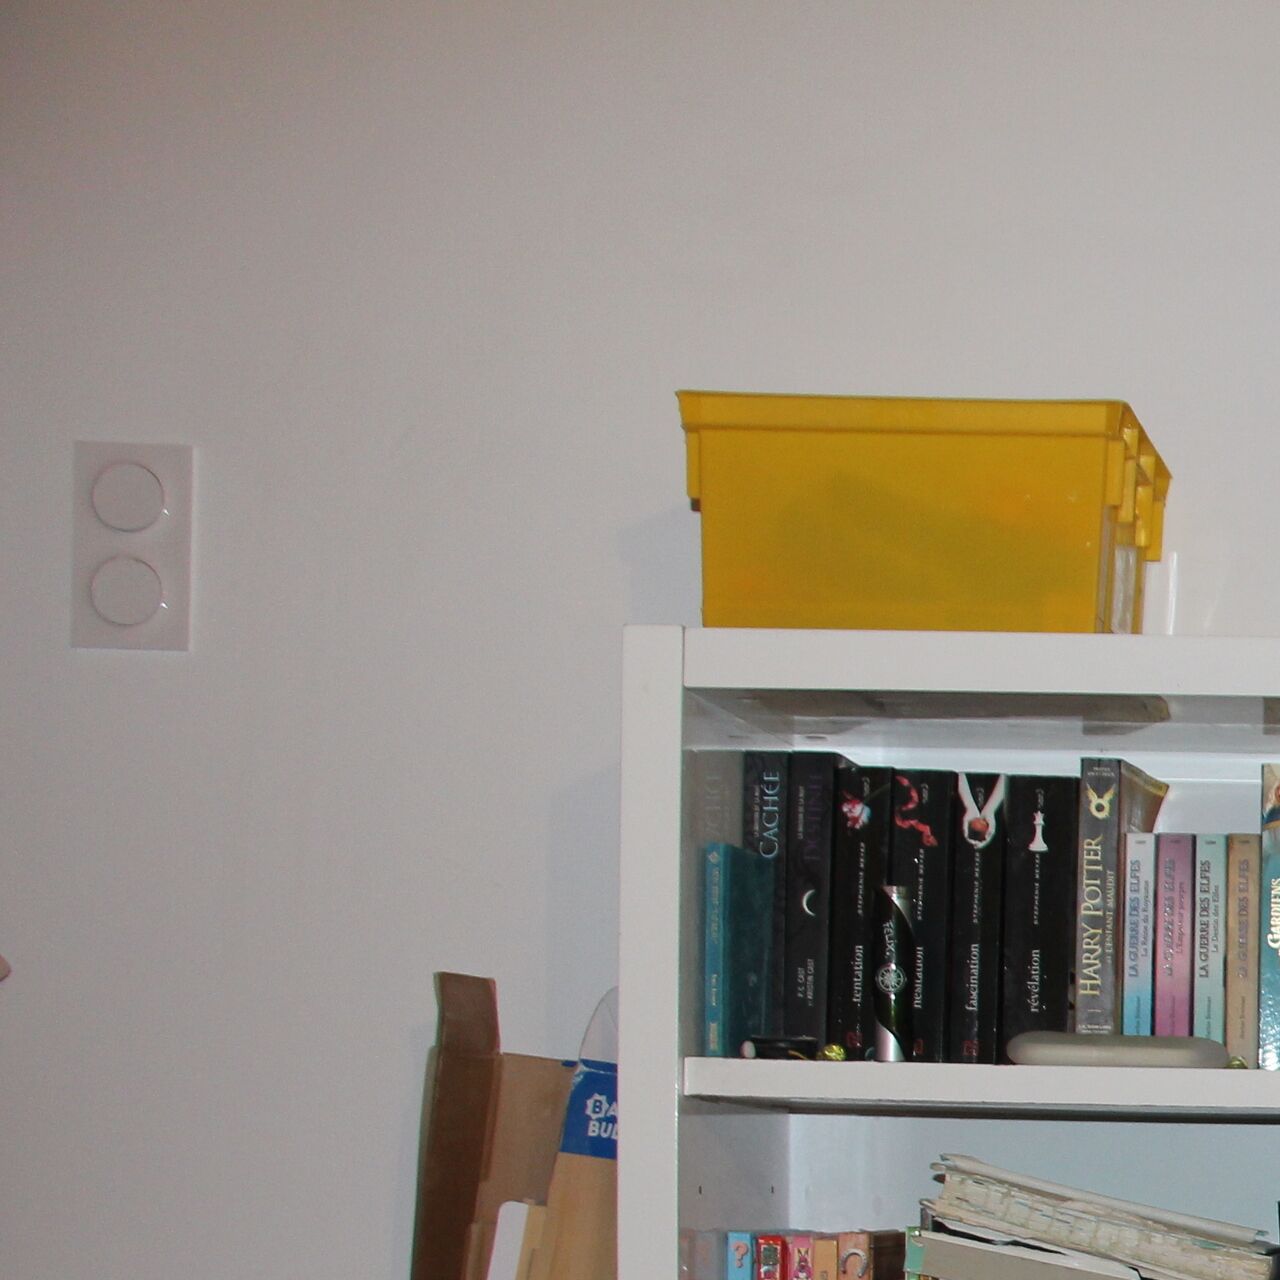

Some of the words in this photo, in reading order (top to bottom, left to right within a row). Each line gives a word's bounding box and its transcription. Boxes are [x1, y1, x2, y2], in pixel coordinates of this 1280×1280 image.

[1081, 834, 1104, 916] POTTER
[1106, 870, 1114, 908] MAUDIT
[1130, 860, 1140, 893] ELFES
[1200, 860, 1210, 893] ELFES
[1129, 898, 1140, 917] DES
[1200, 897, 1210, 918] DES
[1105, 911, 1114, 952] L'ENFANT
[1129, 919, 1140, 962] GUERRE
[1199, 921, 1210, 963] GUERRE
[1211, 921, 1219, 943] Destin
[1212, 945, 1218, 953] Le
[851, 945, 864, 1002] tentation
[966, 943, 980, 1011] fascination
[1080, 922, 1103, 996] HARRY
[1129, 964, 1139, 977] LA
[1199, 965, 1209, 977] LA
[1026, 949, 1040, 1012] révélation
